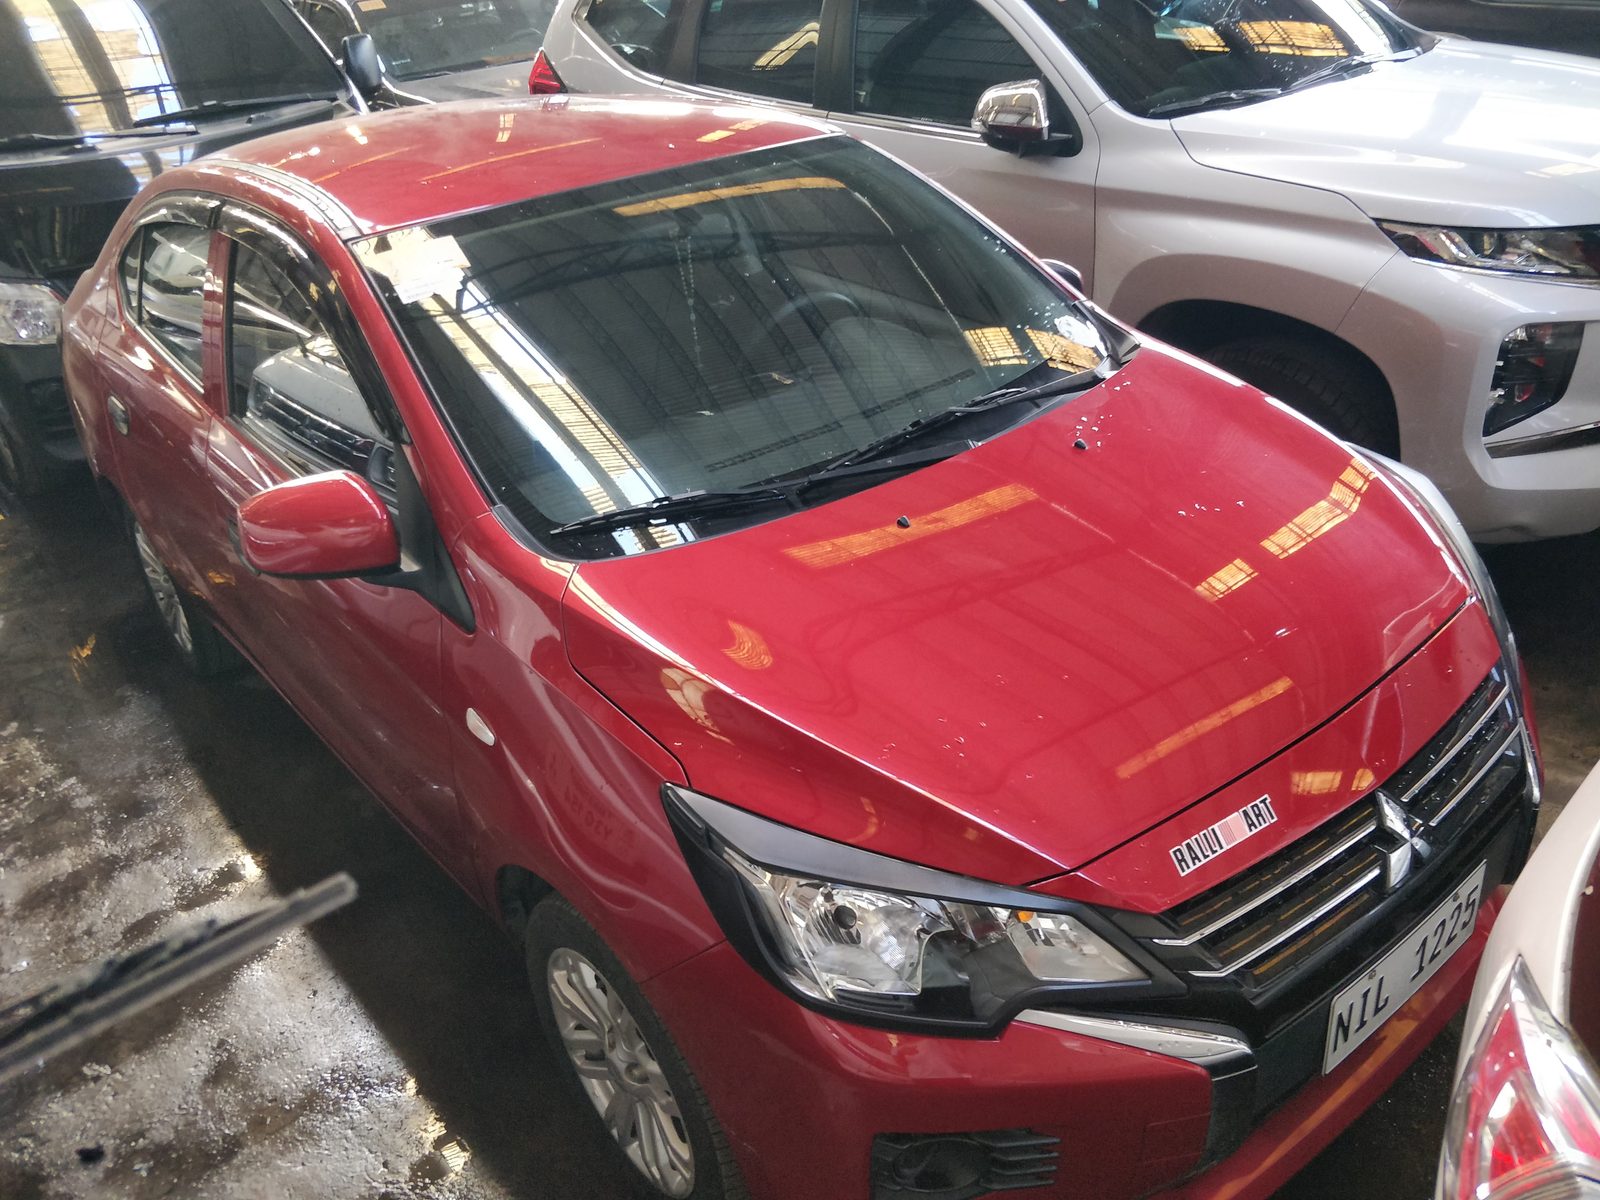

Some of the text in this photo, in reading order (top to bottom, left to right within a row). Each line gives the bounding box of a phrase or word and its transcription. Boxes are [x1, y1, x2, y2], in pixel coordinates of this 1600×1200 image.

[1171, 796, 1275, 873] RALLI ART
[1333, 884, 1479, 1053] NIL 1225
